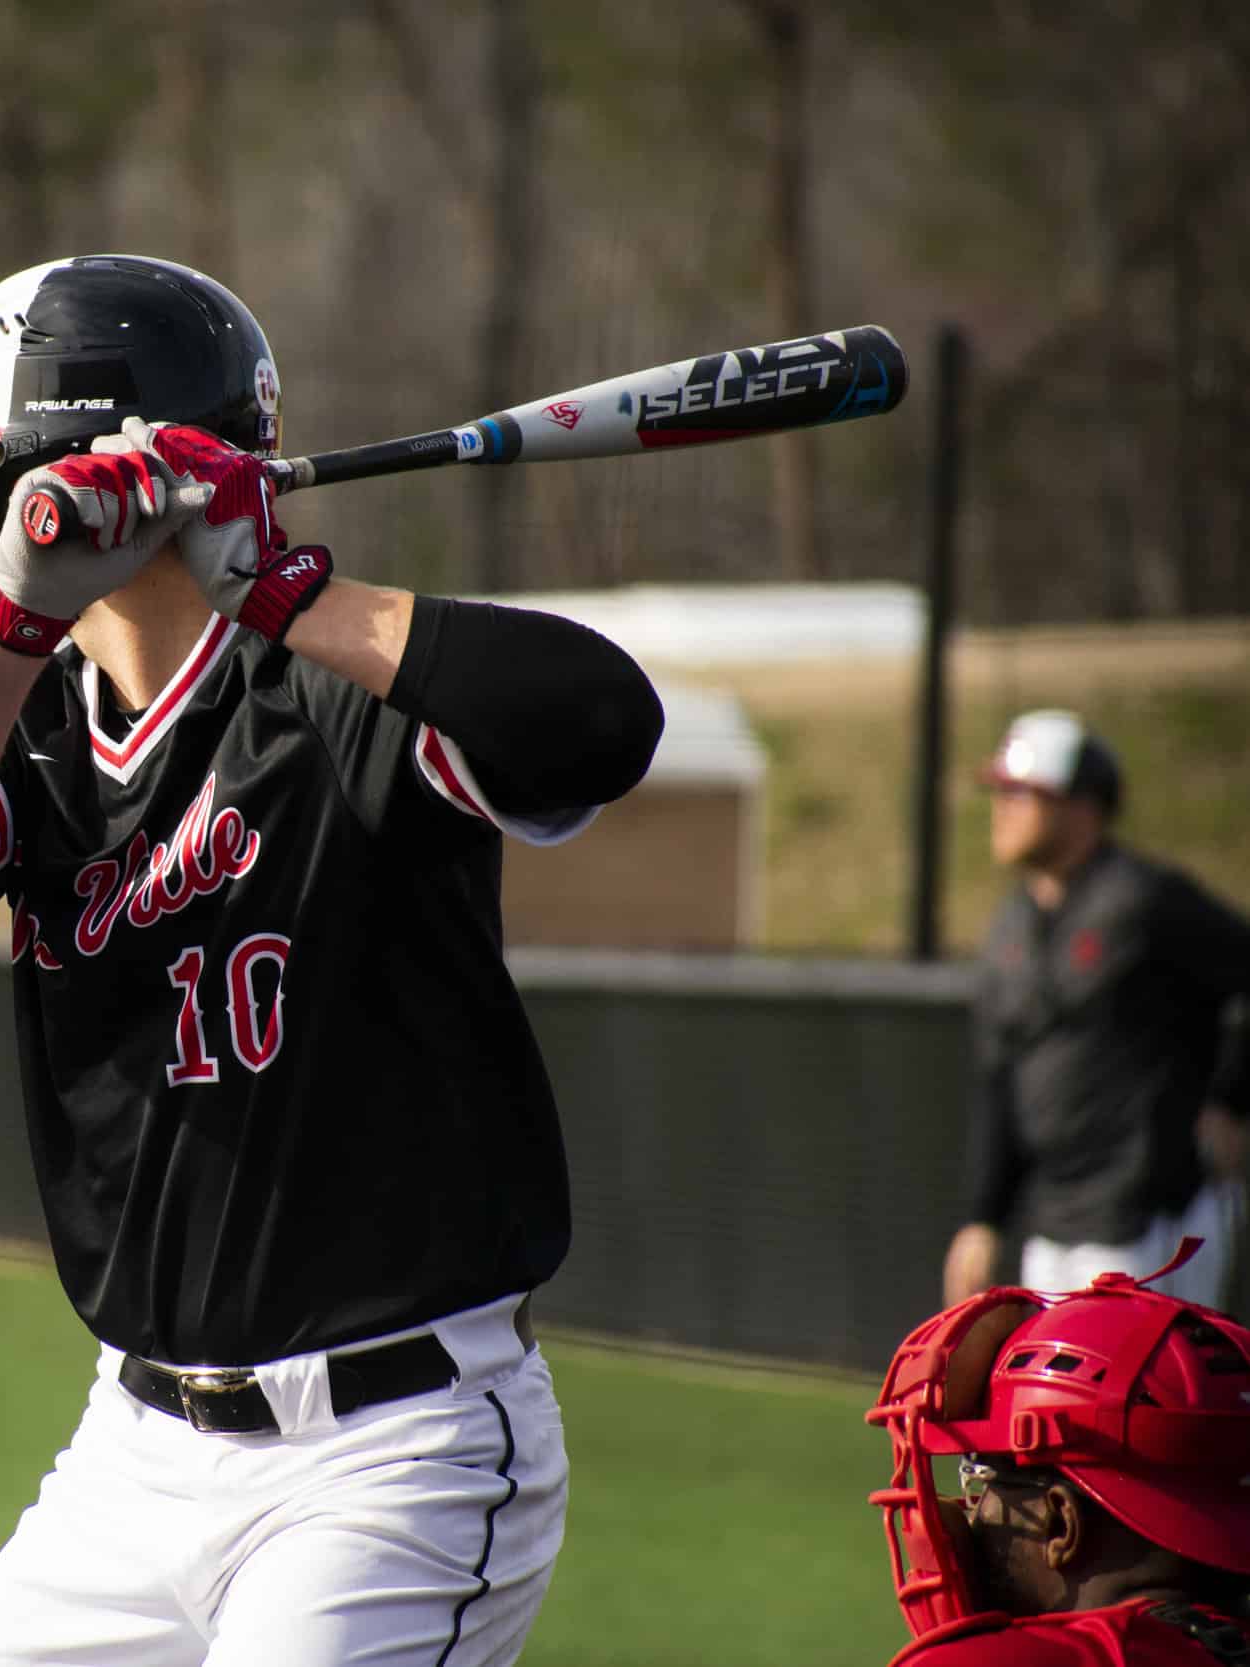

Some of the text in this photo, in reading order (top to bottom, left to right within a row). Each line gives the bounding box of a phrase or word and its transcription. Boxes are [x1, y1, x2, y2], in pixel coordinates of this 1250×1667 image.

[25, 399, 114, 411] RAWLINGS
[644, 359, 840, 421] SELECT
[165, 932, 293, 1088] 10
